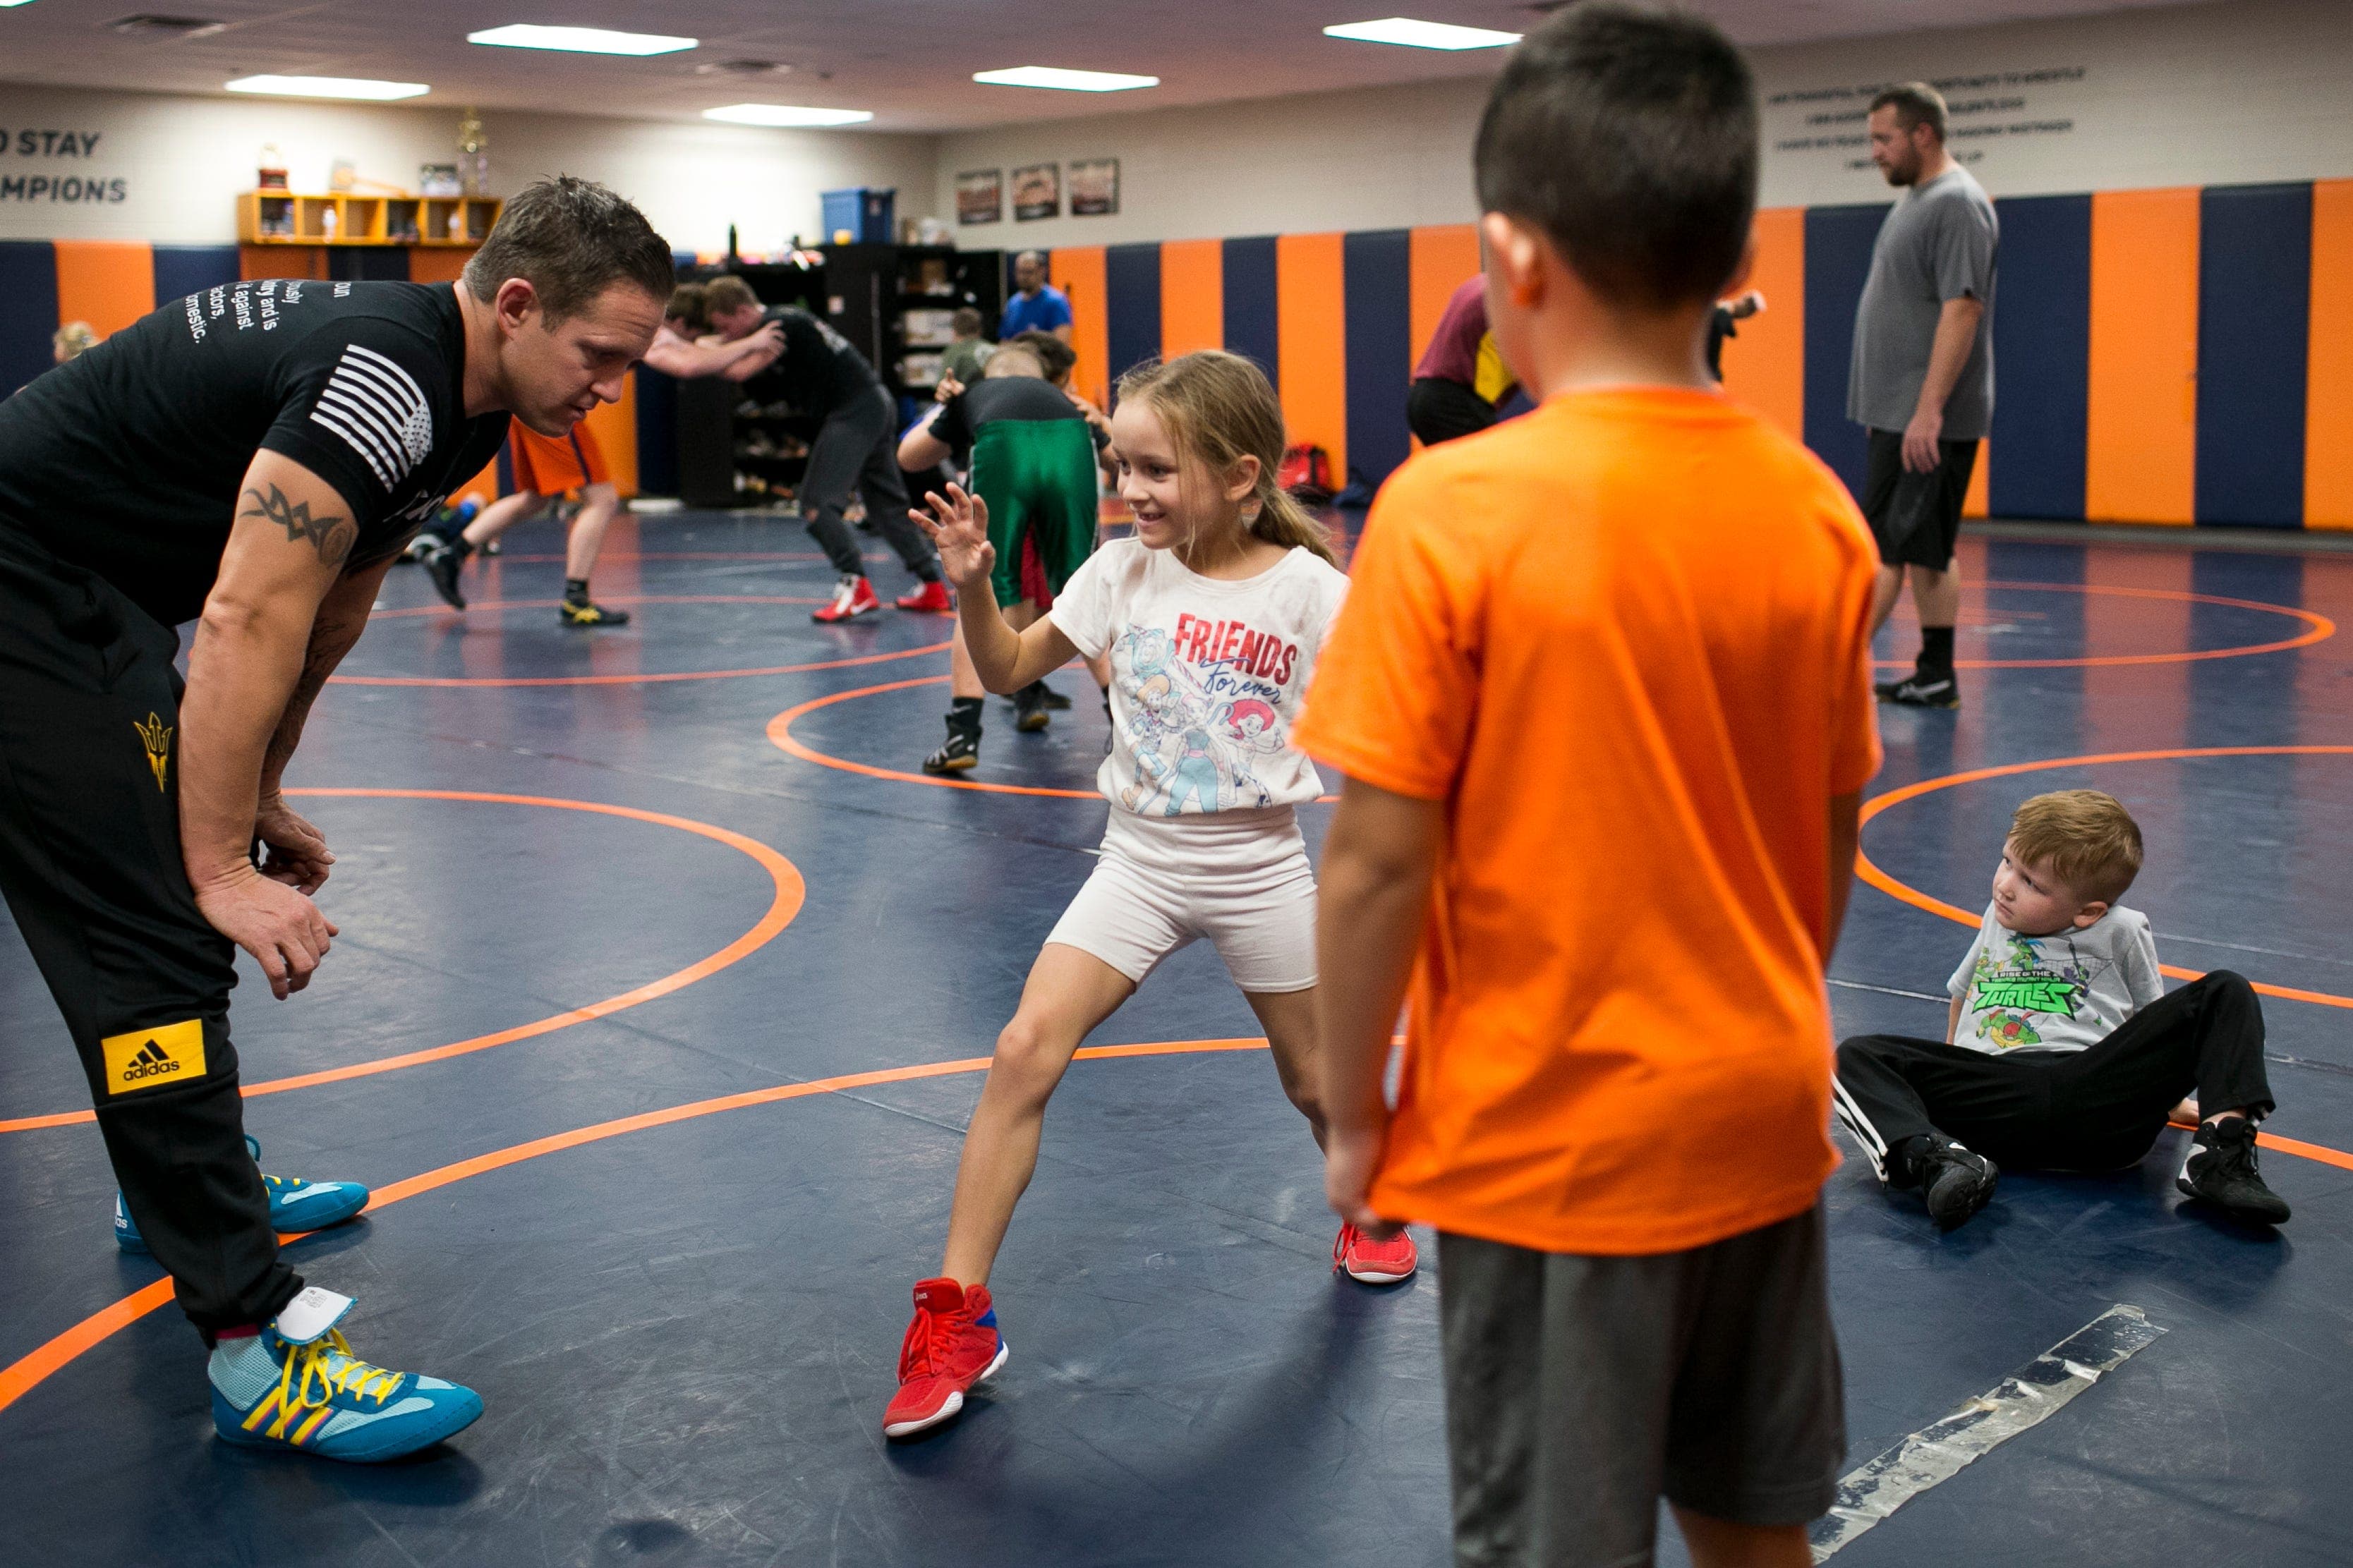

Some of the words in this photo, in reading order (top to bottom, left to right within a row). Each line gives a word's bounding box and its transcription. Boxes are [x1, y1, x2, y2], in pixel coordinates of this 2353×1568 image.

[18, 130, 101, 156] STAY
[185, 291, 207, 344] omestic.
[230, 290, 255, 330] against
[260, 298, 279, 318] and
[262, 317, 280, 331] is
[1173, 612, 1298, 686] FRIENDS
[1199, 656, 1282, 705] Forever
[1973, 980, 2076, 1019] TURTLES
[123, 1060, 181, 1081] adidas
